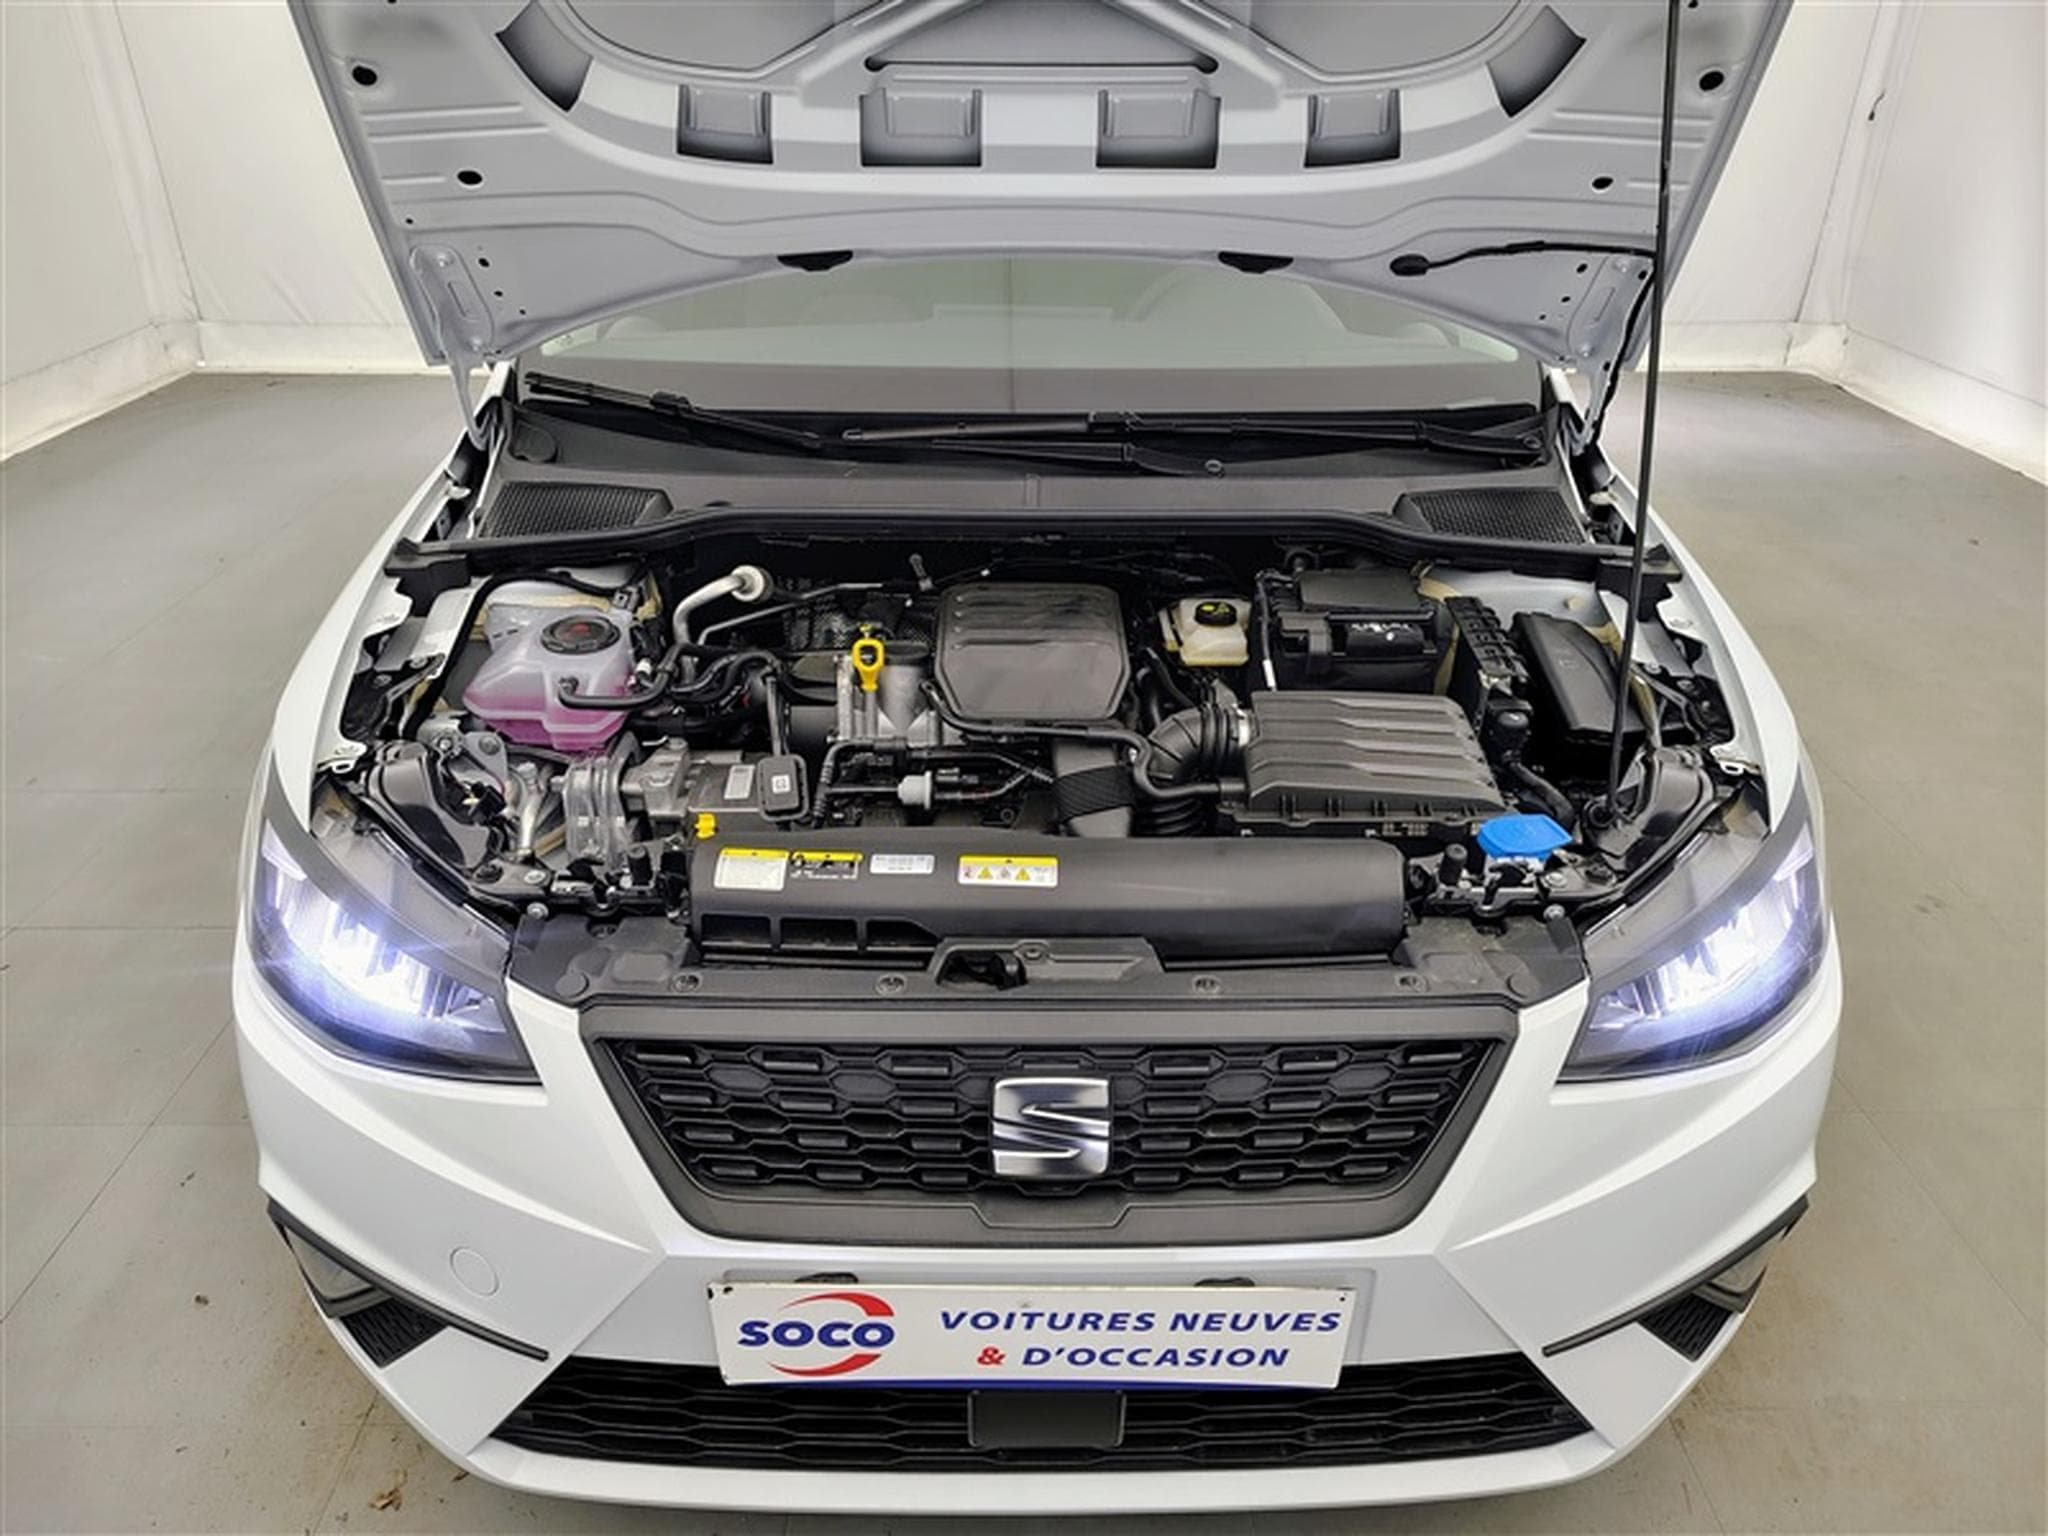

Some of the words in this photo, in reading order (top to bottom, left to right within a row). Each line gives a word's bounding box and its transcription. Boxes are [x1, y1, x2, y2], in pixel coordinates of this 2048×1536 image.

[941, 1311, 1156, 1332] VOITURES
[1169, 1312, 1342, 1332] NEUVES
[737, 1320, 895, 1348] SOCO
[976, 1346, 1006, 1366] &
[1022, 1347, 1290, 1367] D'OCCASION
